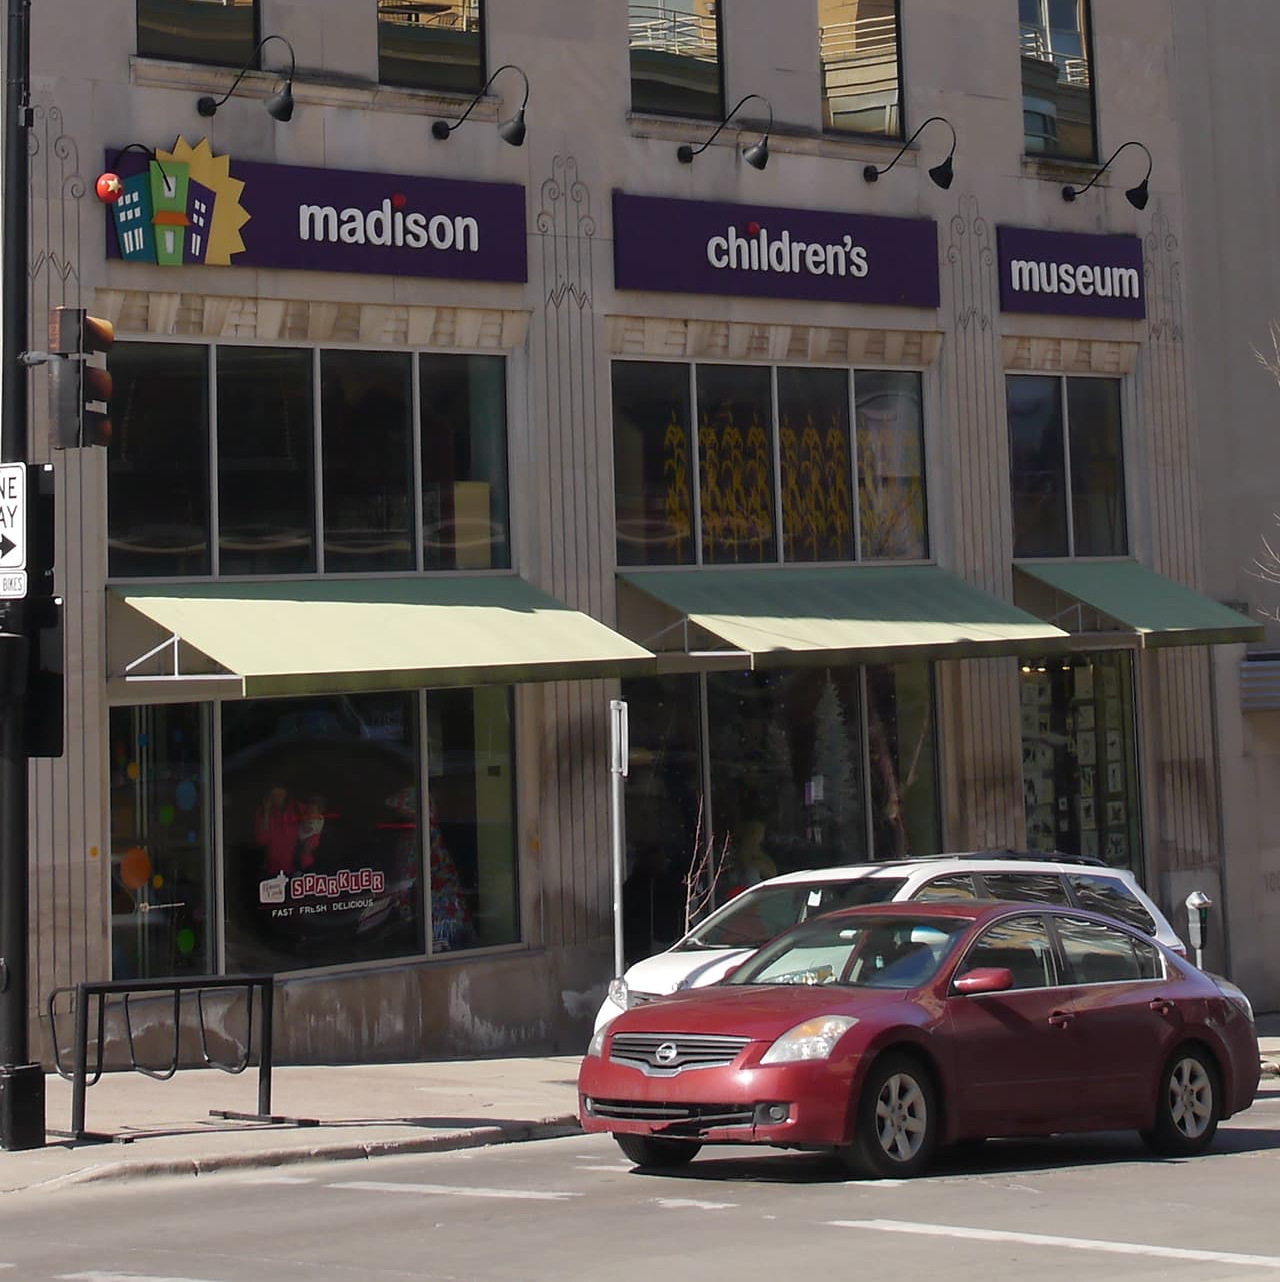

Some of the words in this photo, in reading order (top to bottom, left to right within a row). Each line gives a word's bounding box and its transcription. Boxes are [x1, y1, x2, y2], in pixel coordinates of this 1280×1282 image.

[299, 194, 478, 252] madison
[707, 222, 868, 278] children's
[1010, 257, 1139, 298] museum
[3, 577, 23, 592] BIKES
[292, 871, 383, 897] SPARKLER
[272, 908, 294, 918] FAST
[333, 899, 374, 911] DELICIOUS
